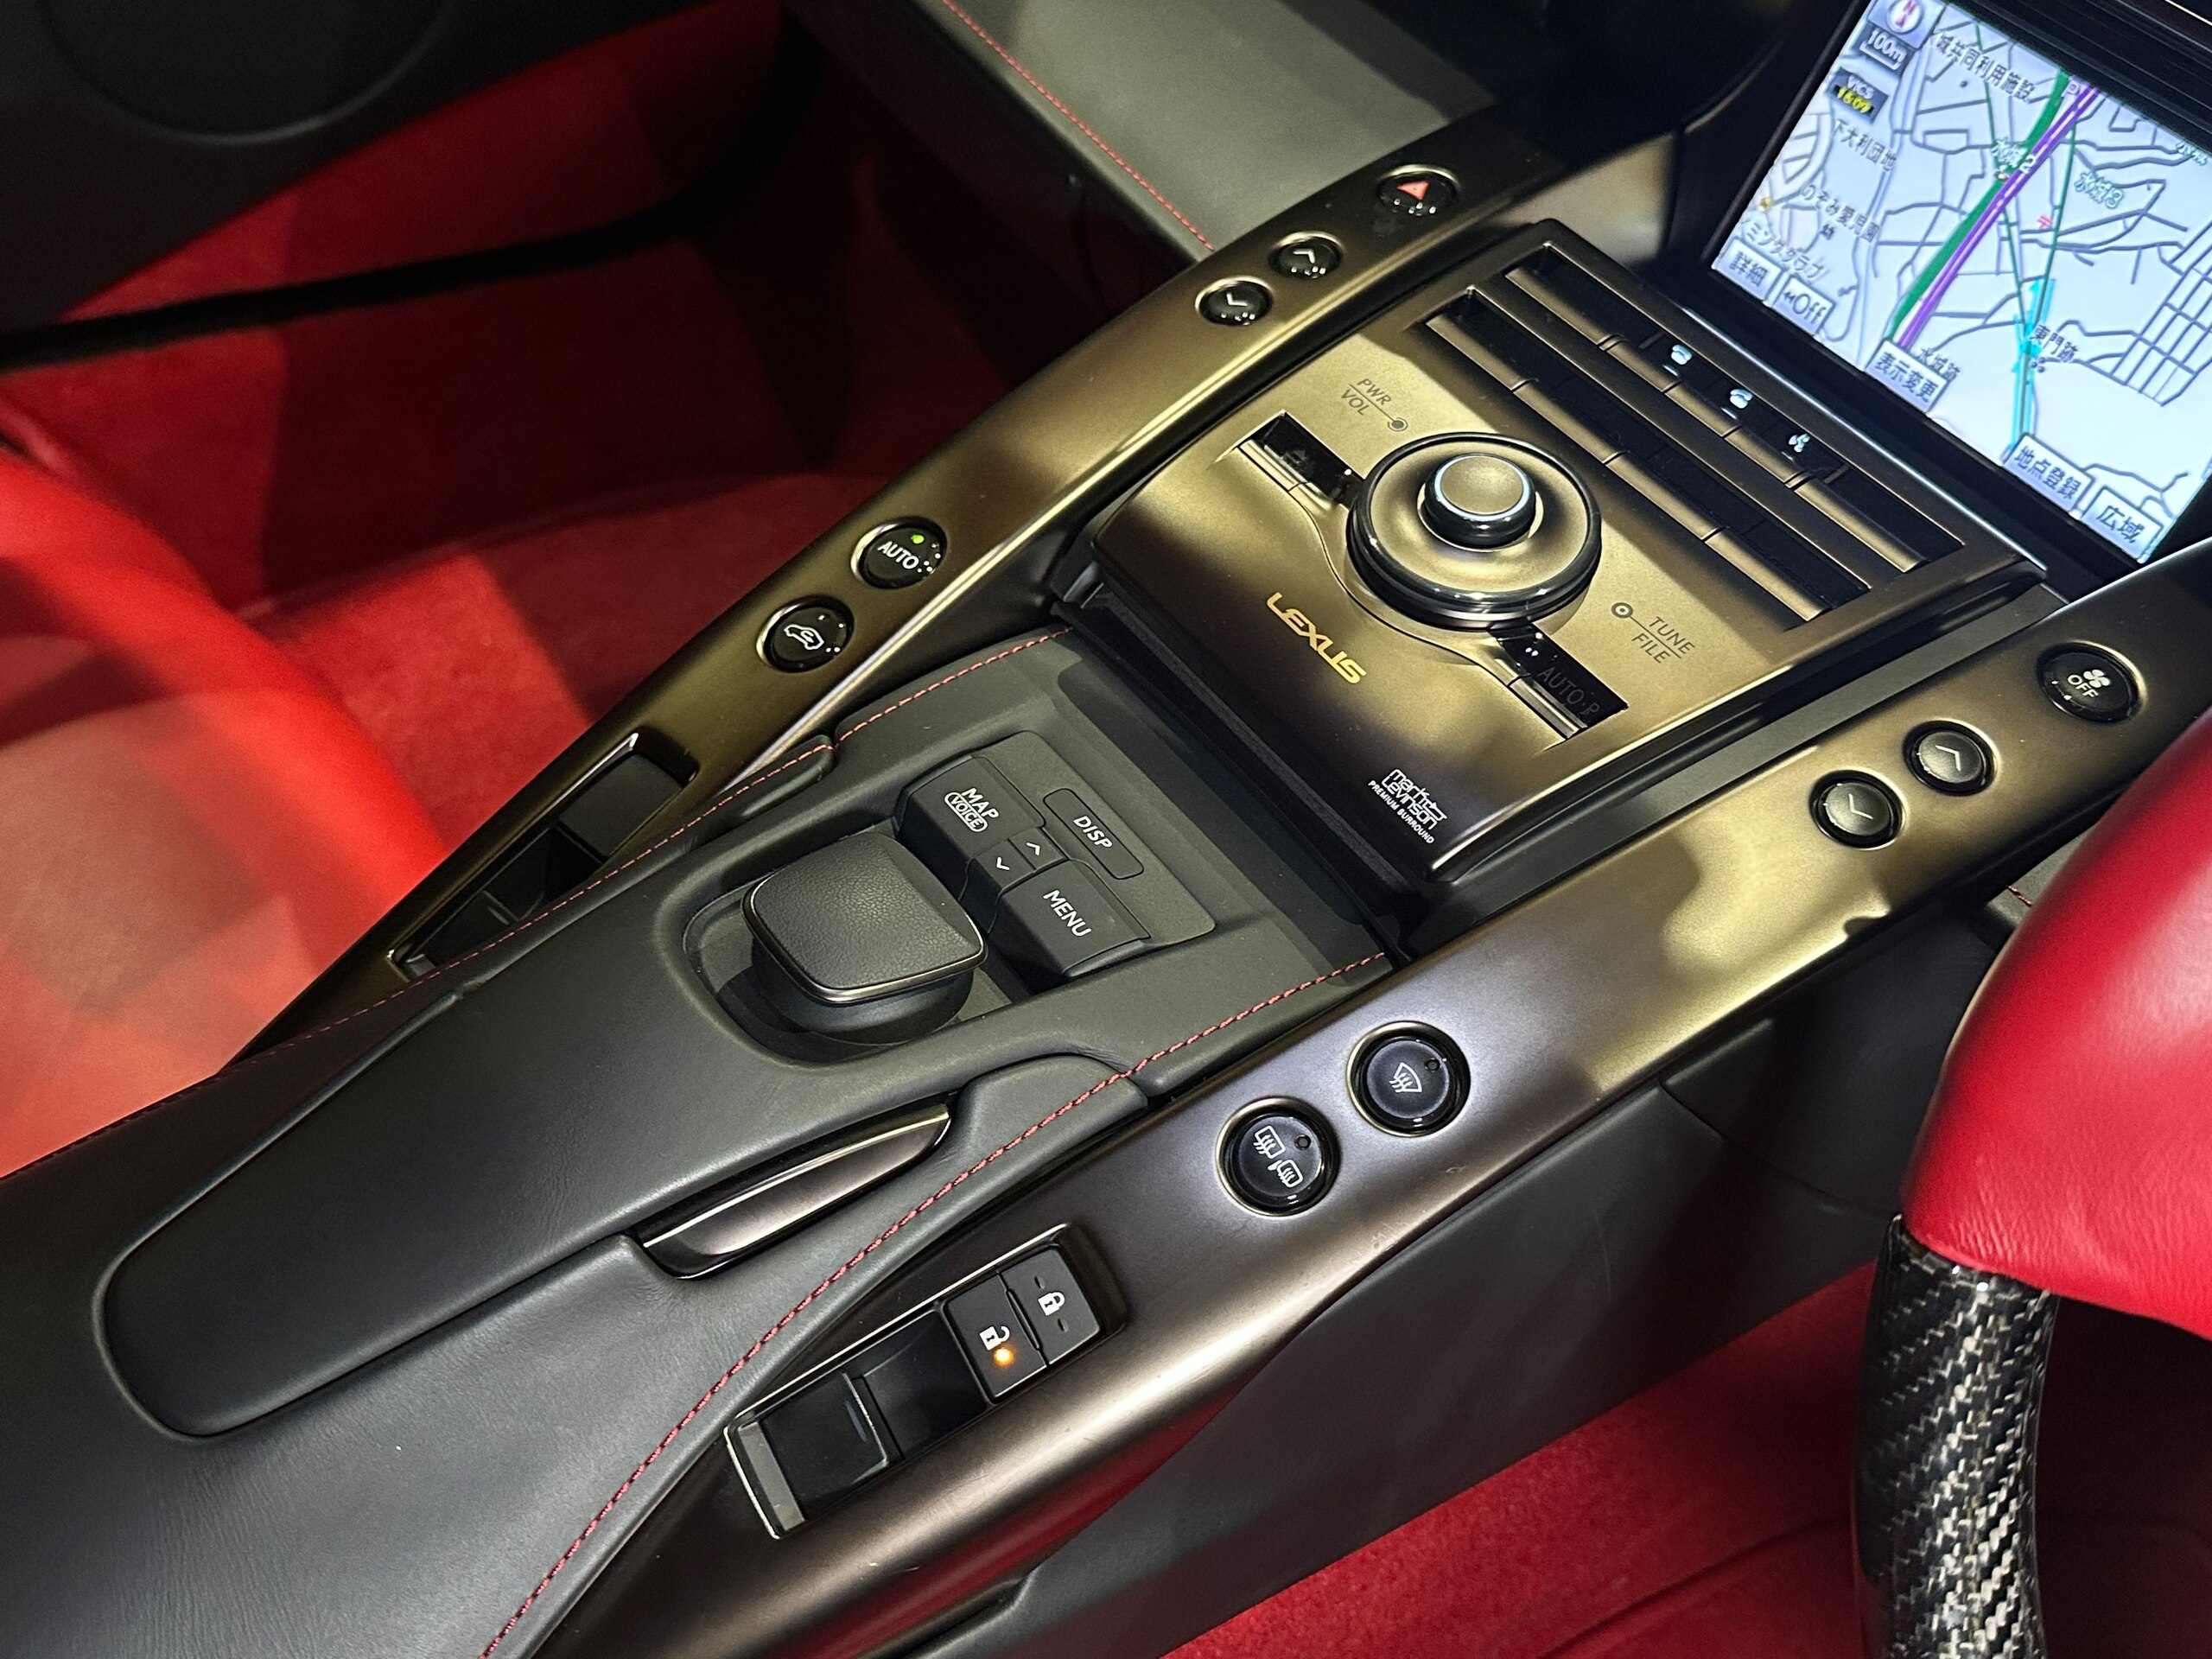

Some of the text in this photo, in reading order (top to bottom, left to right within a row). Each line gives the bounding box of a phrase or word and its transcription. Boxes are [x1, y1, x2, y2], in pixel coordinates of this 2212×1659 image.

[1868, 29, 1907, 63] 100m
[1357, 378, 1392, 405] PWR
[1875, 351, 1939, 404] 表示変更
[1341, 389, 1370, 416] VOL
[2013, 445, 2082, 499] 地点登録
[2095, 505, 2145, 544] 広域
[877, 541, 919, 569] AUTO
[1267, 592, 1367, 683] LEXUS
[1631, 632, 1672, 664] FILE
[1649, 616, 1695, 655] TUNE
[2067, 674, 2099, 698] OFF
[950, 794, 983, 830] VOICE
[961, 787, 1000, 819] MAP
[1368, 780, 1435, 844] PREMIUM SURROUND
[1073, 815, 1113, 849] DISP
[1043, 889, 1092, 937] MENU
